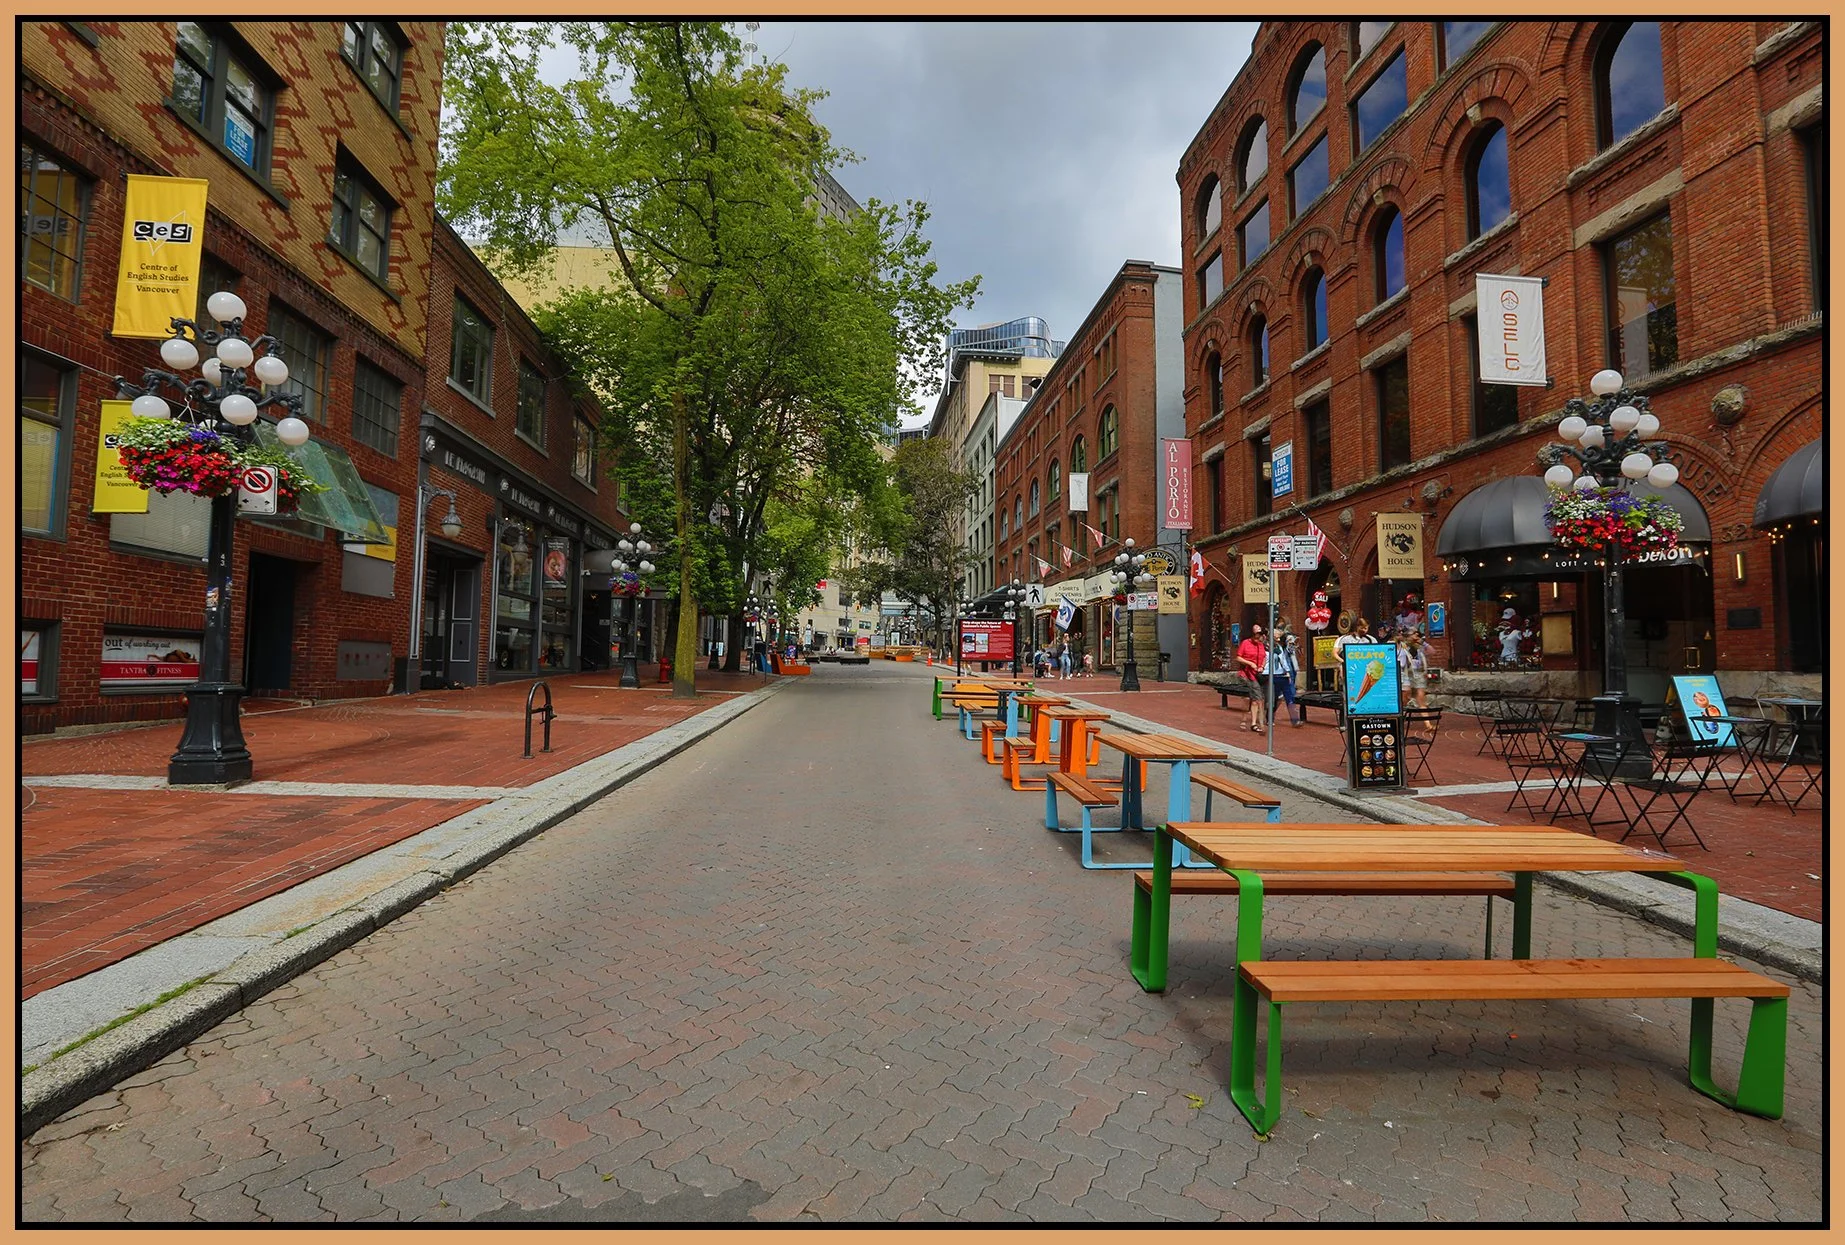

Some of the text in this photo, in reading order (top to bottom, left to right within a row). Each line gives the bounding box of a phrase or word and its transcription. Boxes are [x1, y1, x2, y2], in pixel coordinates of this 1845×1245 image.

[140, 263, 168, 271] Centre
[127, 272, 189, 282] English Studies
[136, 285, 180, 294] Vancouver
[1503, 313, 1520, 371] SELC
[1276, 457, 1287, 468] FOR
[1274, 464, 1289, 478] LEASE
[1168, 442, 1179, 519] AL PORTO
[105, 639, 123, 647] out
[125, 640, 132, 648] of
[132, 641, 159, 650] working
[1348, 651, 1386, 660] GELATO
